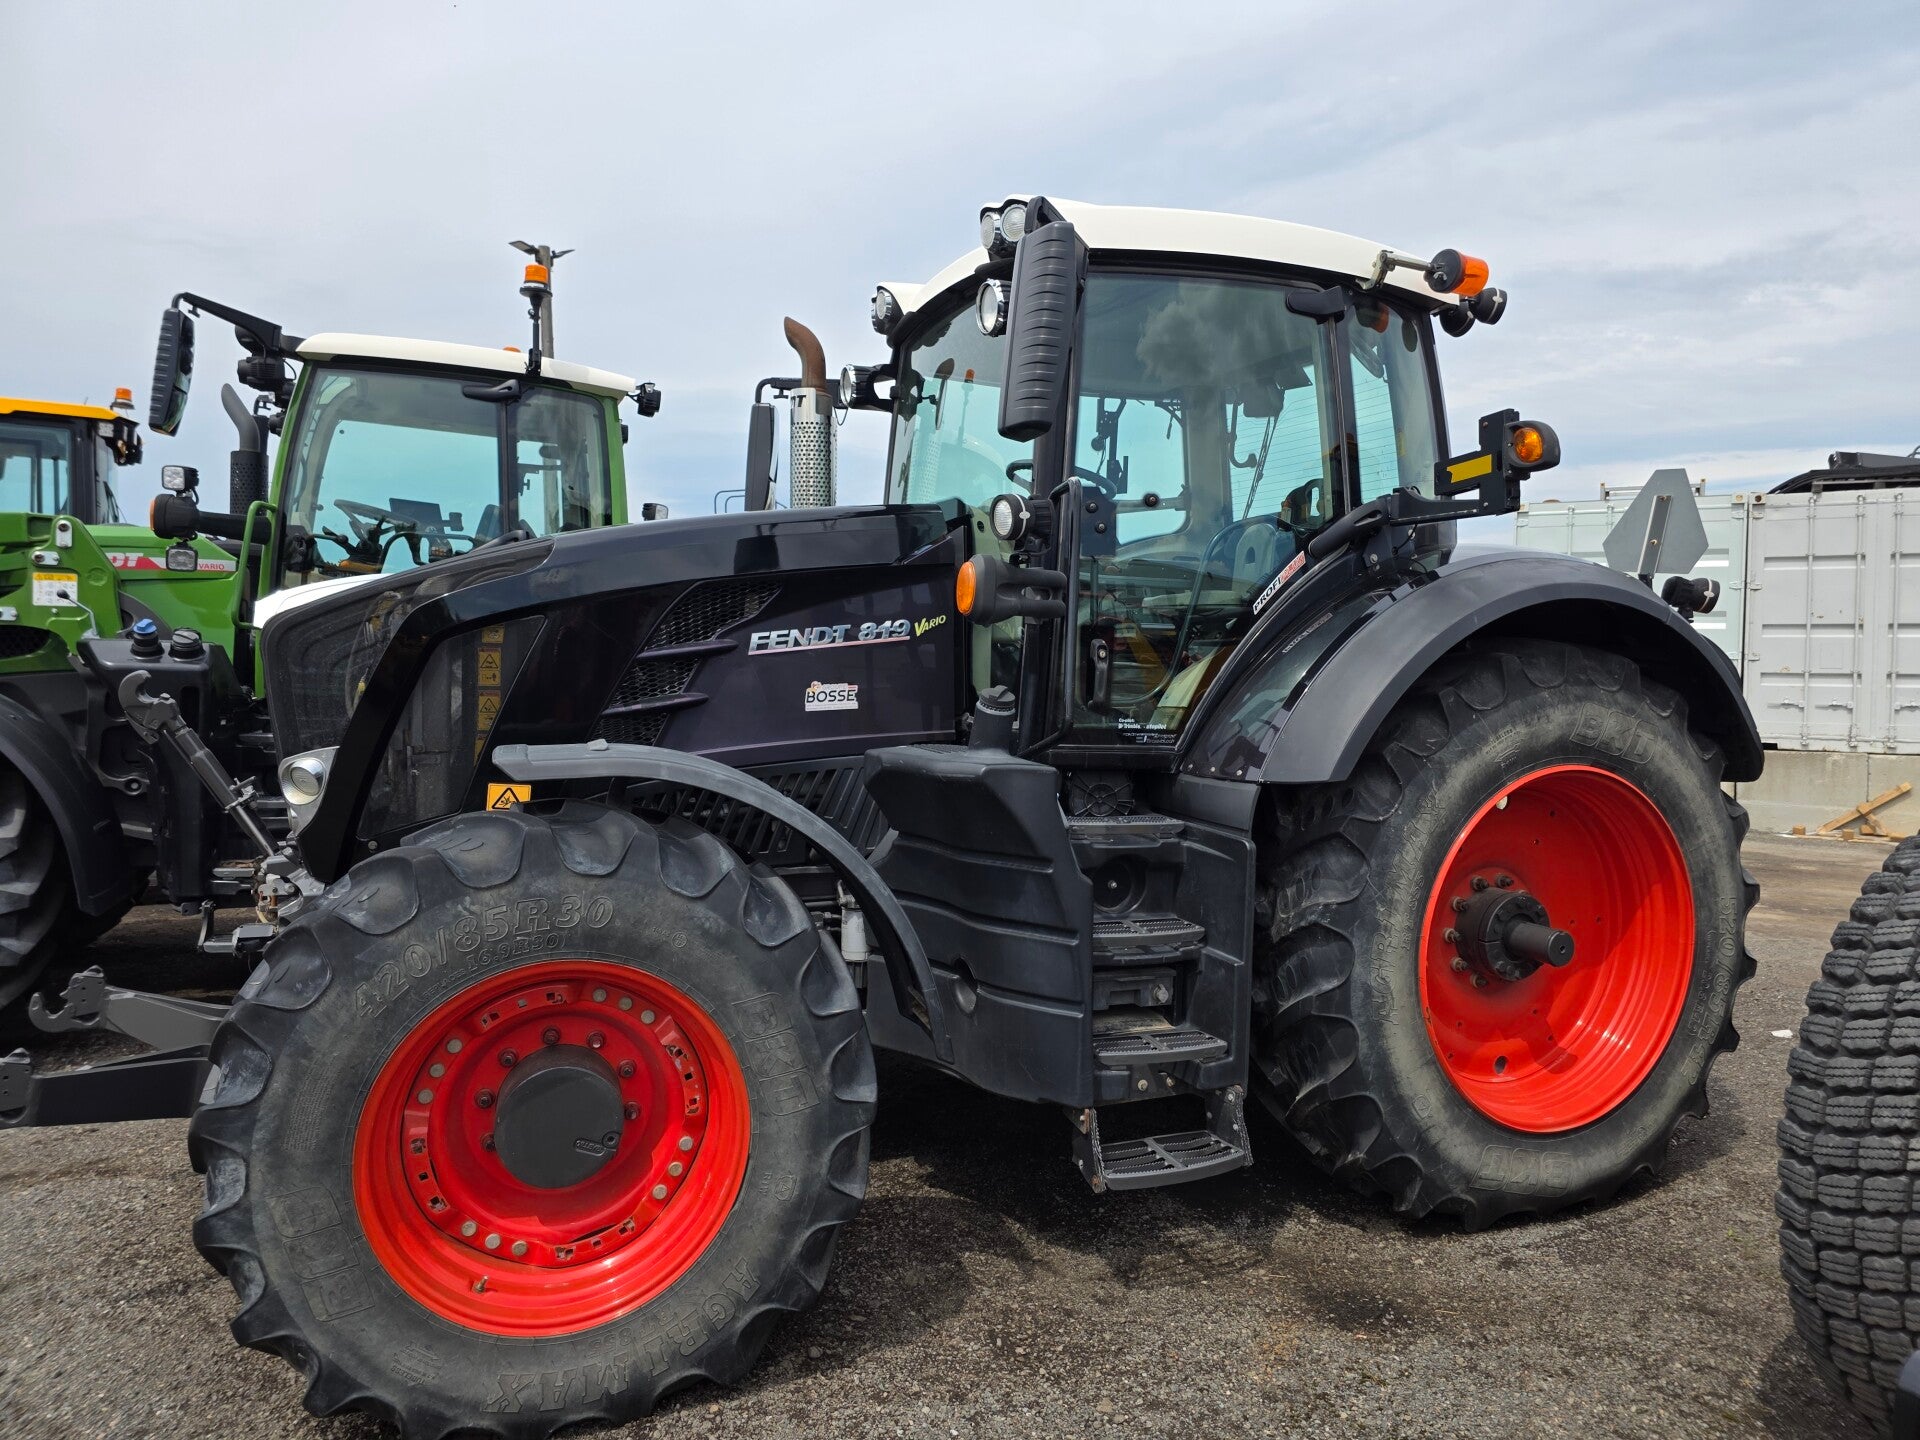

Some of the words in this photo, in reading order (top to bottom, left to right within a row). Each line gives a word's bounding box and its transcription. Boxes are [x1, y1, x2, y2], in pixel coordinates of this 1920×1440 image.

[1253, 577, 1282, 612] PROFI
[750, 624, 851, 652] FENDT
[858, 619, 911, 642] 819
[806, 689, 856, 703] BOSSE
[354, 895, 614, 1018] 420/85R30
